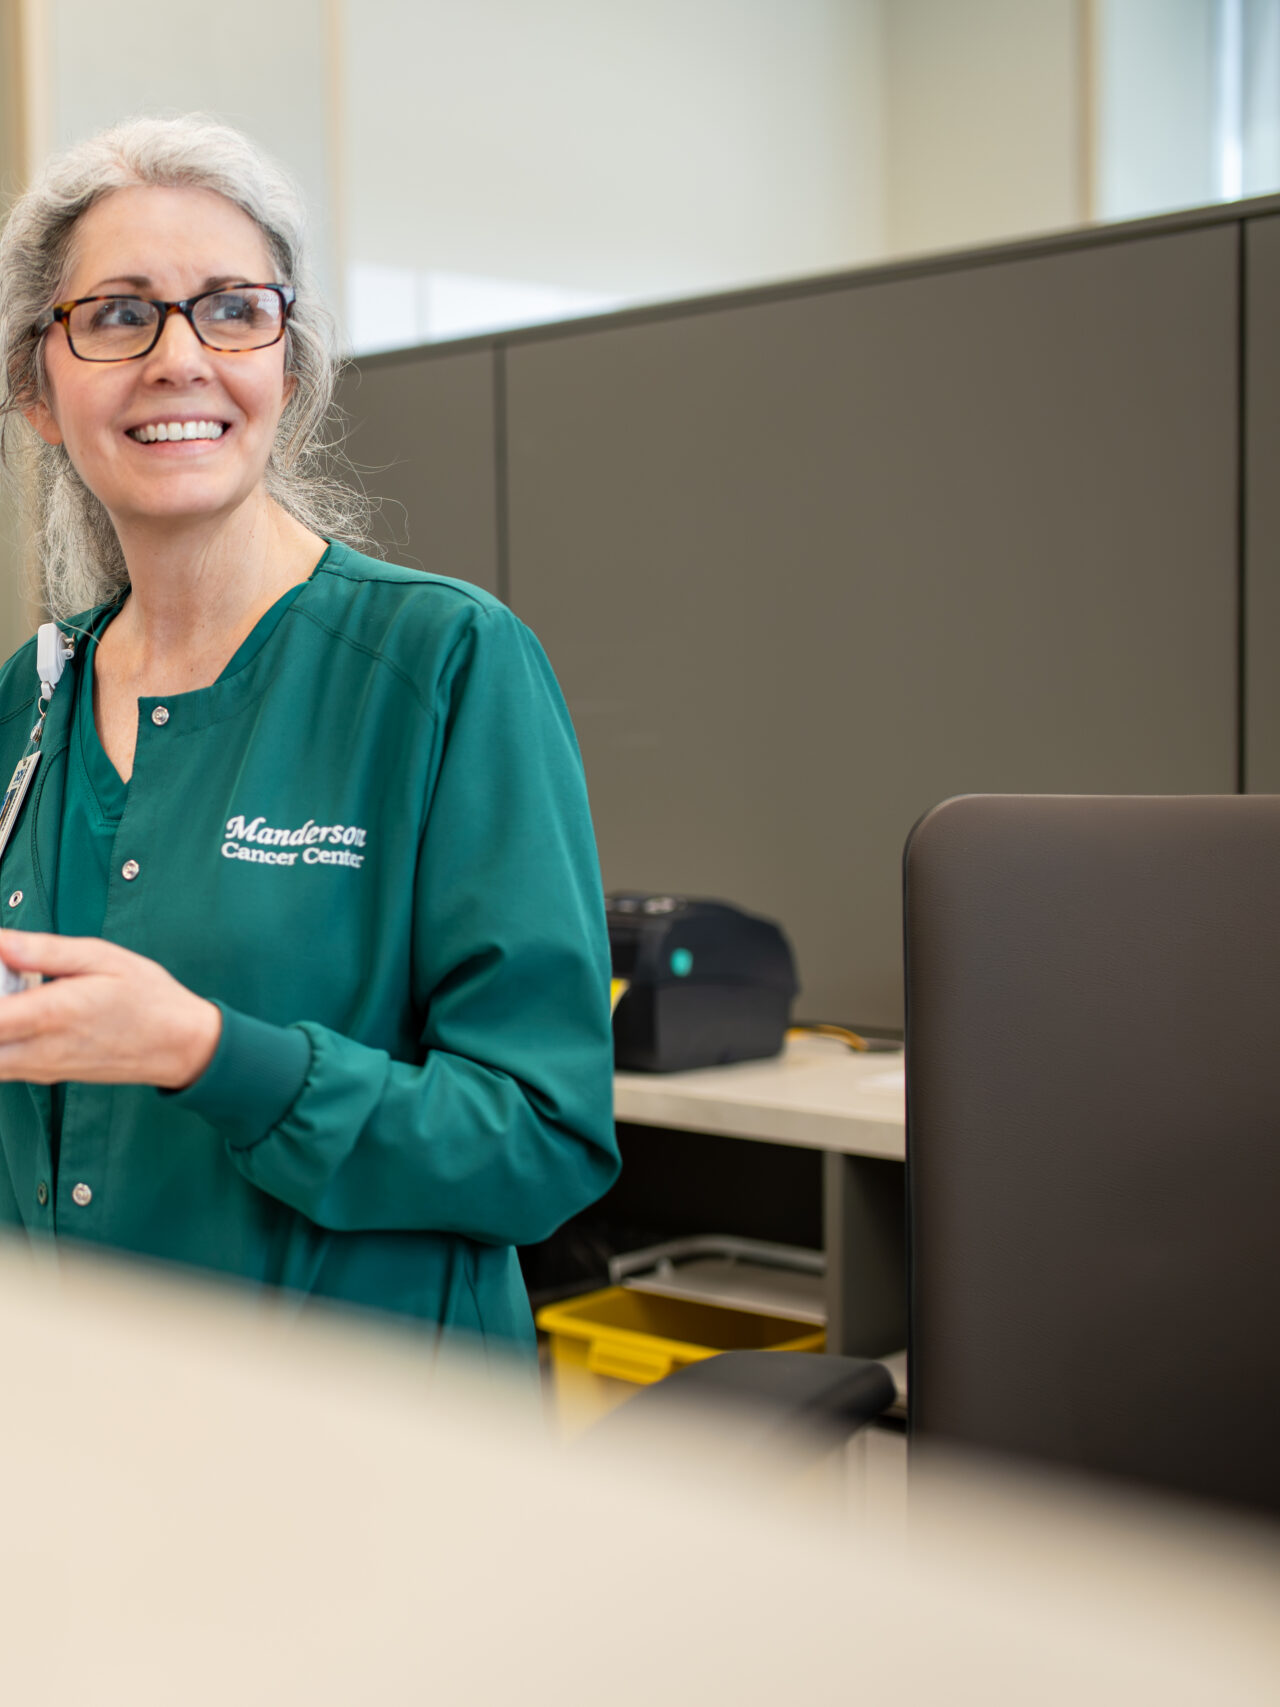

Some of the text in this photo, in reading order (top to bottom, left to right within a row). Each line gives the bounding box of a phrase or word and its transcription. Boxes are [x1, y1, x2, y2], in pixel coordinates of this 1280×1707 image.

[225, 815, 367, 847] Manderson
[221, 842, 365, 869] Cancer Center
